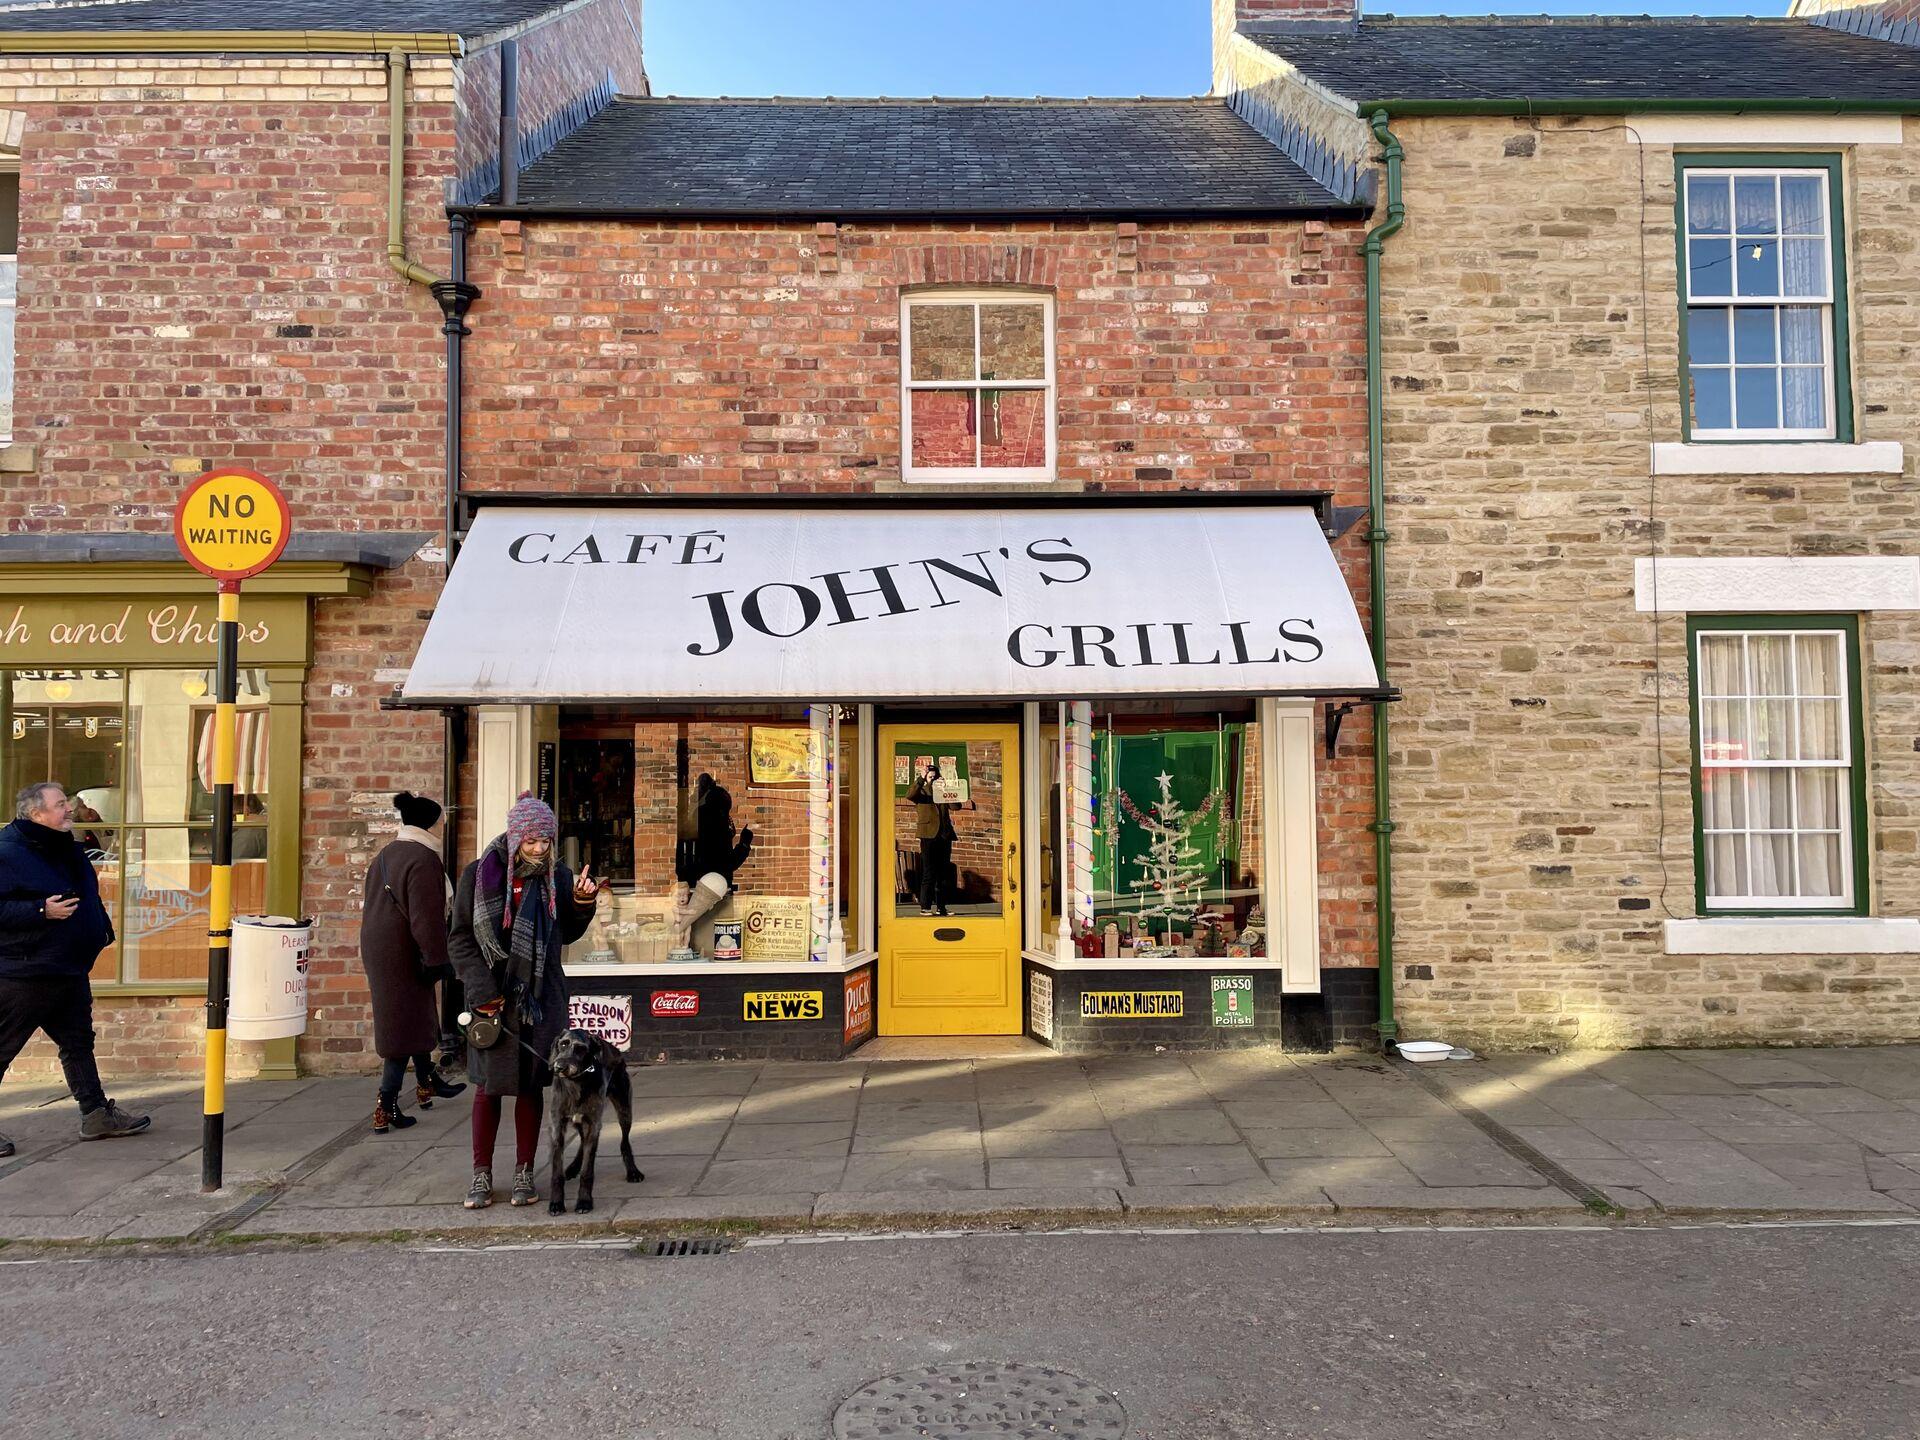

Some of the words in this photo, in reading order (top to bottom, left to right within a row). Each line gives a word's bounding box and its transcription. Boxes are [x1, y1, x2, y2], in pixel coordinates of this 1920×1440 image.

[209, 494, 255, 519] NO
[189, 527, 272, 545] WAITING
[508, 530, 726, 564] CAFÉ
[686, 537, 1092, 656] JOHN'S
[50, 605, 132, 644] and
[1007, 618, 1323, 667] GRILLS
[747, 911, 803, 934] COFFEE
[756, 992, 810, 1000] EVENING
[1213, 978, 1251, 992] BRASSO
[581, 1002, 625, 1022] SALOON
[747, 1000, 820, 1019] NEWS
[845, 980, 870, 1031] PUCK
[1082, 993, 1131, 1015] COLMAN'S
[1133, 992, 1181, 1014] MUSTARD
[1215, 1015, 1252, 1025] Polish
